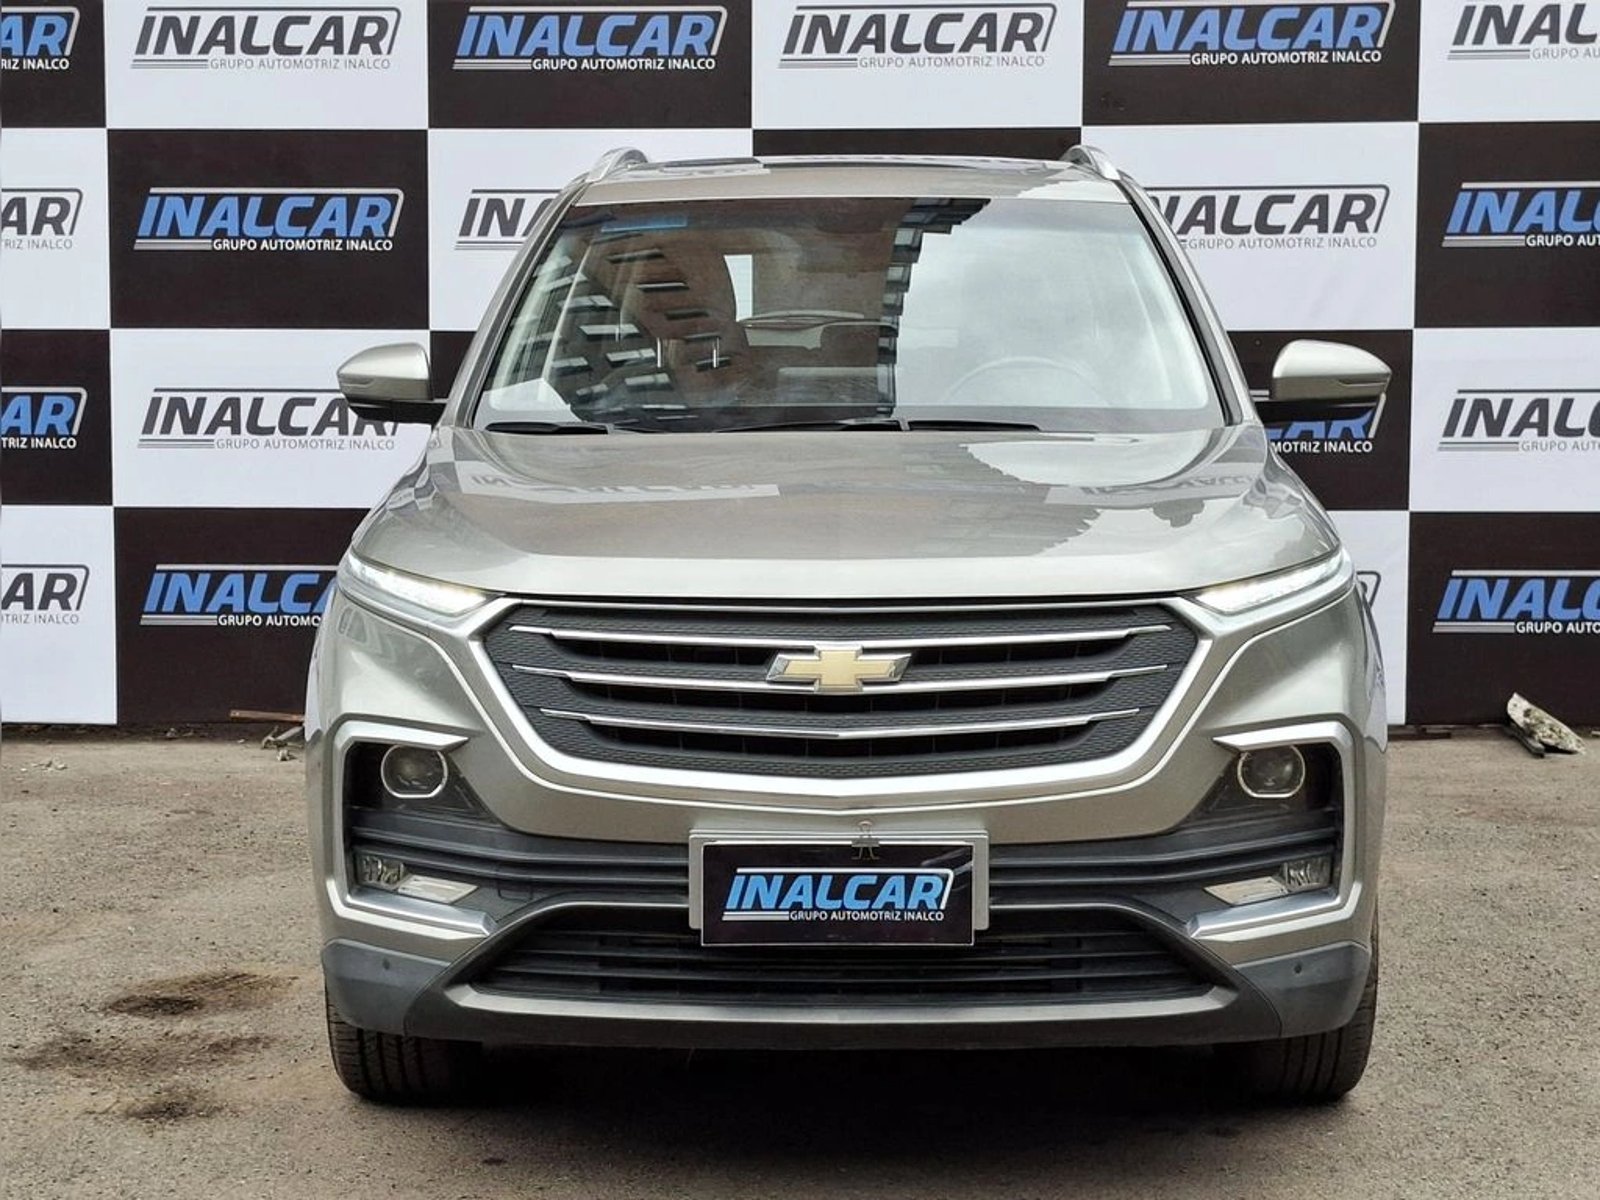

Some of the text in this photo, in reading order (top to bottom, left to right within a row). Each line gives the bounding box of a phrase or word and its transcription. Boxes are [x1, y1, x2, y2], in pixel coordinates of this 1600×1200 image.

[135, 15, 390, 55] INALCAR
[782, 12, 1044, 54] INALCAR
[1113, 6, 1381, 52] INALCAR
[457, 15, 715, 56] INALCAR
[1191, 51, 1381, 65] GRUPO AUTOMOTRIZ INALCO
[1532, 48, 1578, 60] GRUPO
[23, 59, 69, 70] INALCO
[210, 59, 390, 69] GRUPO AUTOMOTRIZ INALCO
[532, 58, 716, 70] GRUPO AUTOMOTRIZ INALCO
[859, 56, 1045, 69] GRUPO AUTOMOTRIZ INALCO
[137, 196, 392, 237] INALCAR
[1446, 189, 1600, 234] INAL
[1, 239, 72, 250] RIZ INALCO
[213, 239, 393, 251] GRUPO AUTOMOTRIZ INALCO
[1189, 237, 1377, 250] GRUPO AUTOMOTRIZ INALCO
[1526, 235, 1573, 247] GRUPO
[1442, 397, 1600, 438] INAL
[31, 437, 76, 449] INALCO
[216, 439, 395, 450] GRUPO AUTOMOTRIZ INALCO
[1324, 441, 1372, 453] INALCO
[1521, 441, 1600, 451] GRUPO AUT
[1, 614, 79, 625] TRIZ INALCO
[218, 614, 262, 626] GRUPO
[1516, 621, 1562, 634] GRUPO
[725, 875, 943, 909] INALCAR
[790, 909, 944, 921] GRUPO AUTOMOTRIZ INALCO
